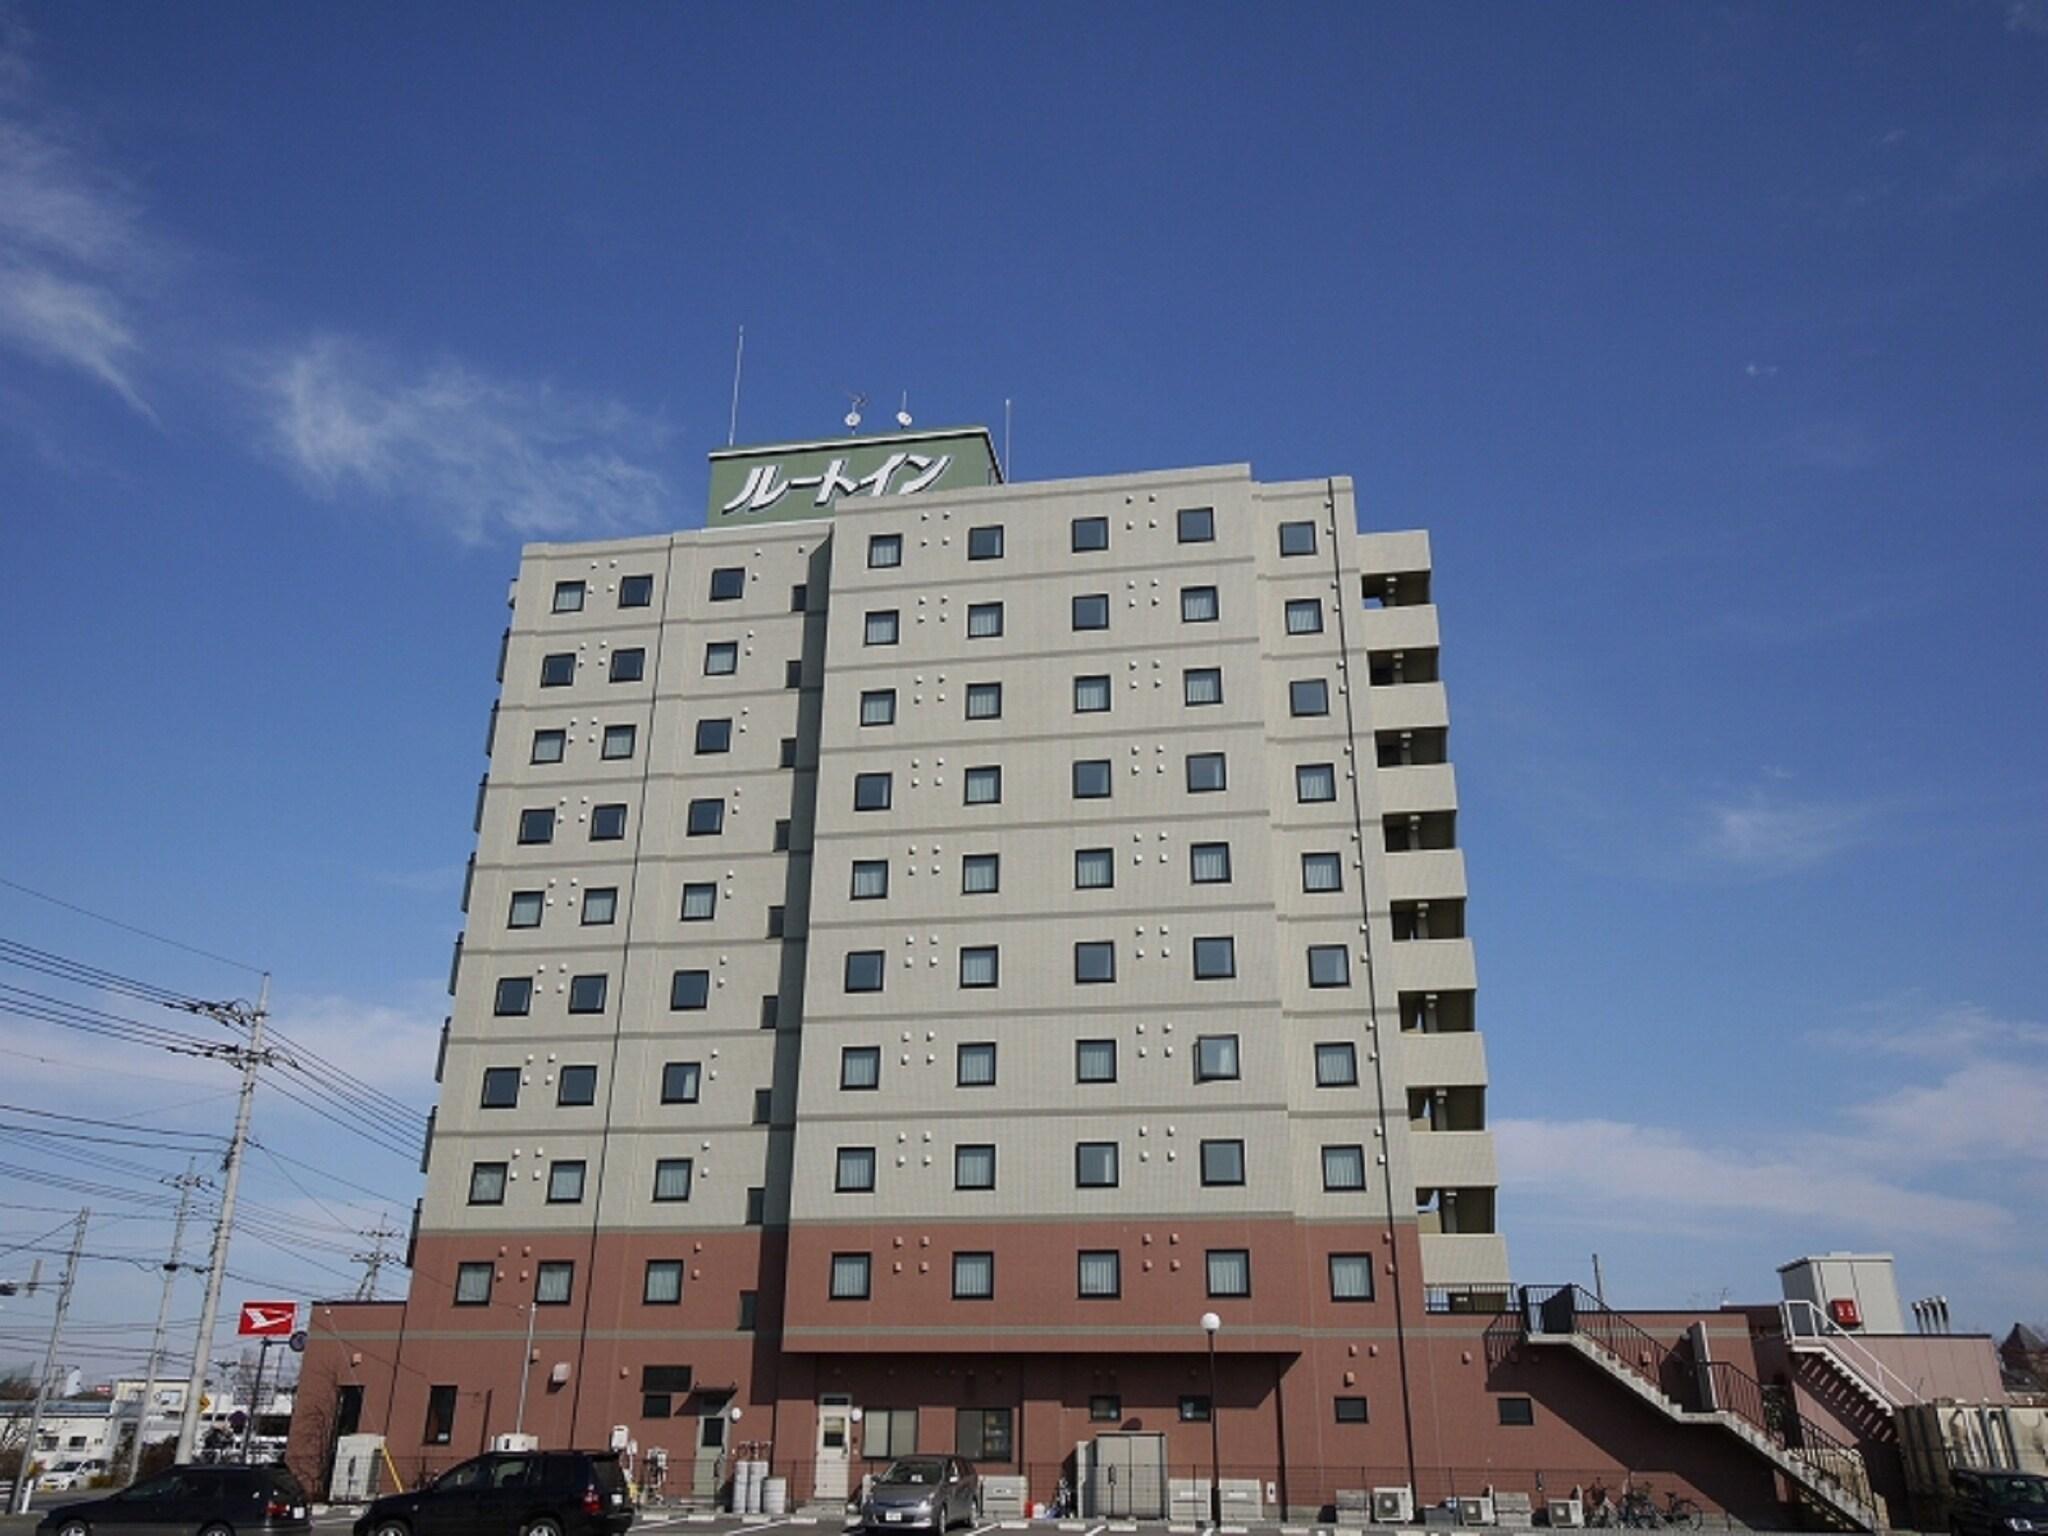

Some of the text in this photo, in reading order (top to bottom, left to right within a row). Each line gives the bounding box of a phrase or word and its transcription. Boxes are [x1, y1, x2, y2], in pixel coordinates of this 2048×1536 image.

[721, 453, 951, 514] ルートイン
